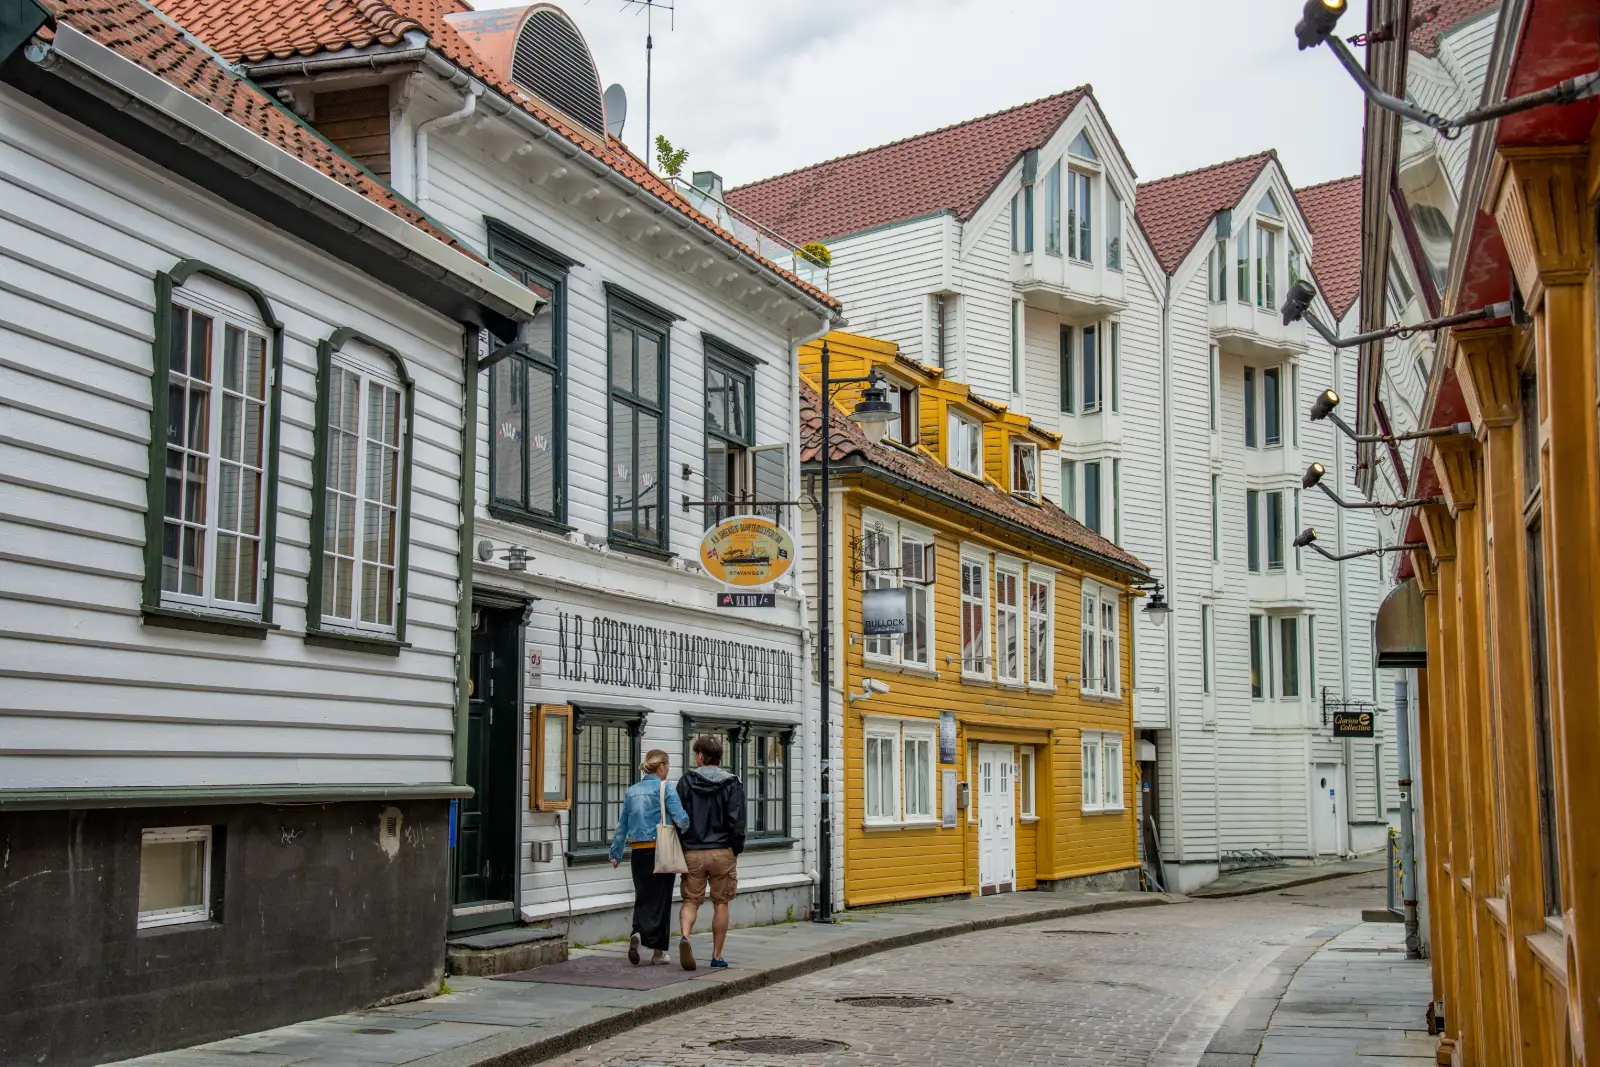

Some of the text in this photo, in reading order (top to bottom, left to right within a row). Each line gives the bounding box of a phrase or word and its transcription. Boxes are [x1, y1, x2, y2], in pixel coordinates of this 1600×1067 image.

[865, 618, 905, 628] BULLOCK
[558, 611, 587, 683] N.B.
[1335, 714, 1359, 725] Clarion
[1340, 724, 1371, 732] Collection
